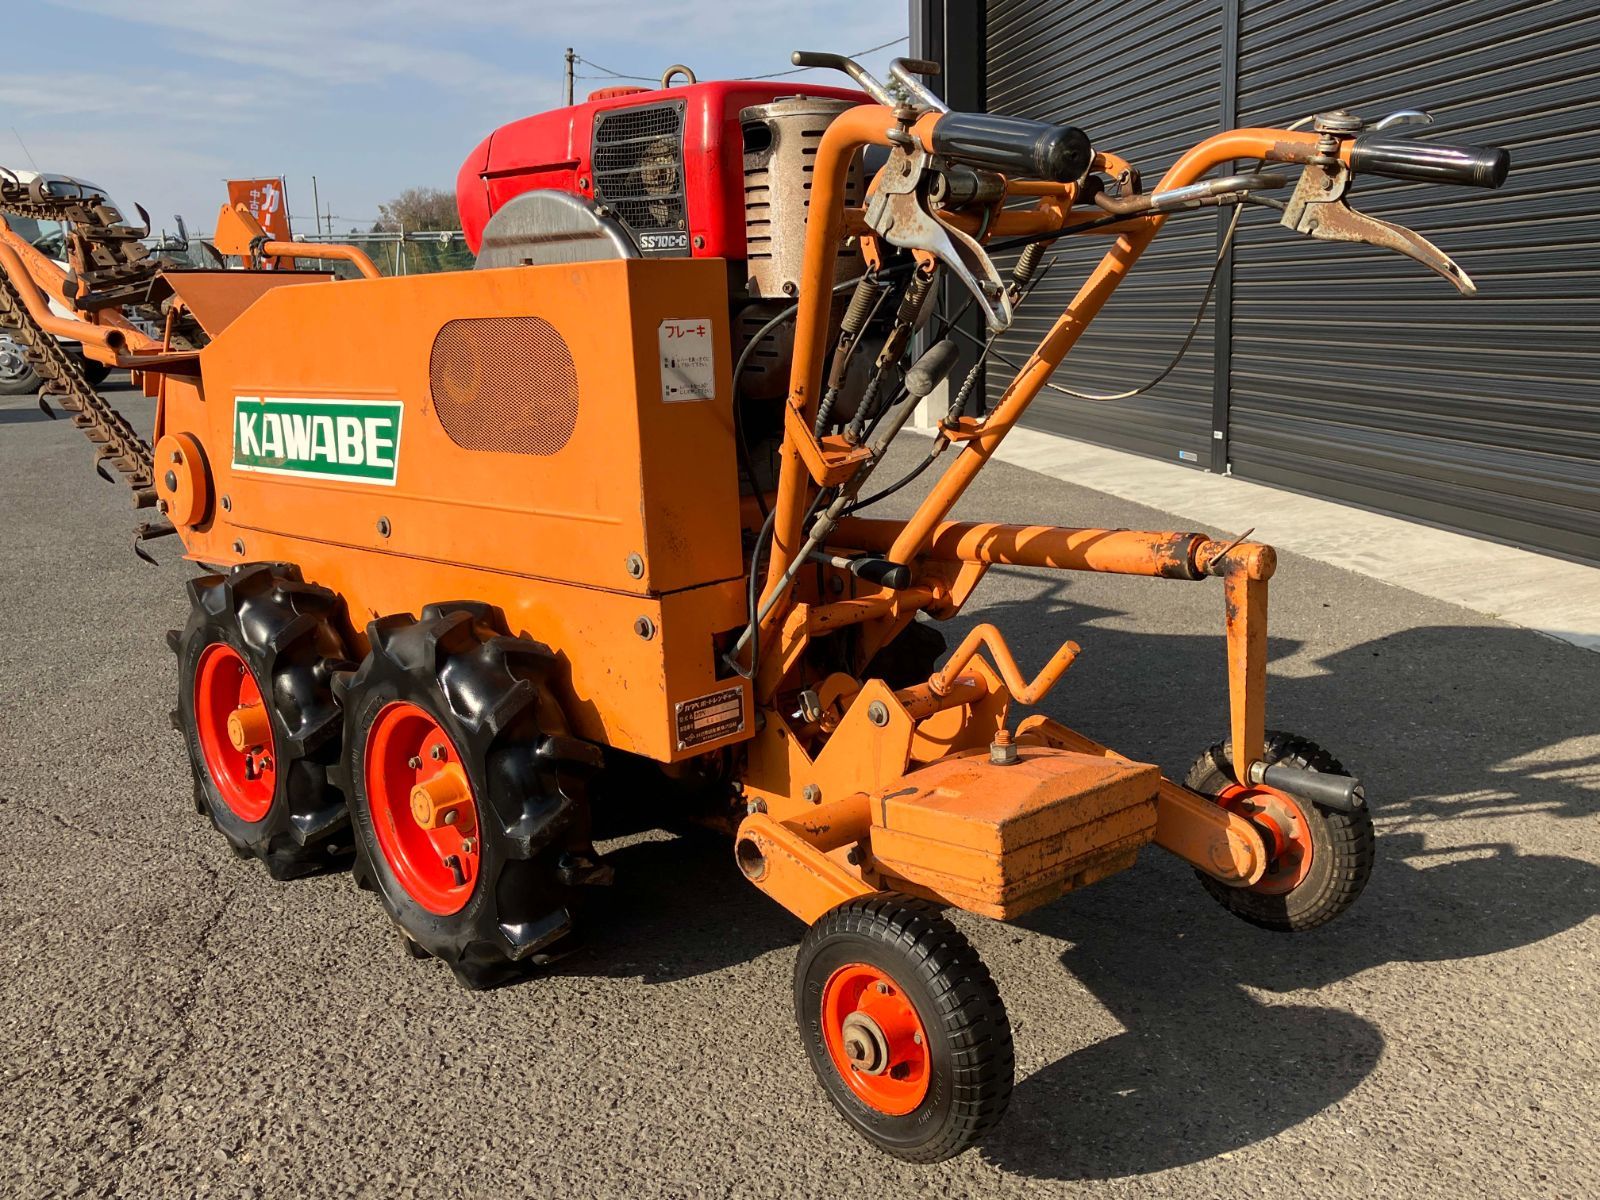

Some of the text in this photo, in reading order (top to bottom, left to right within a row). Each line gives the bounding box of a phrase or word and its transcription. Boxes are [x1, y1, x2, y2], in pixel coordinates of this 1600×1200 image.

[664, 325, 706, 338] ブレーキ
[238, 411, 394, 468] KAWABE
